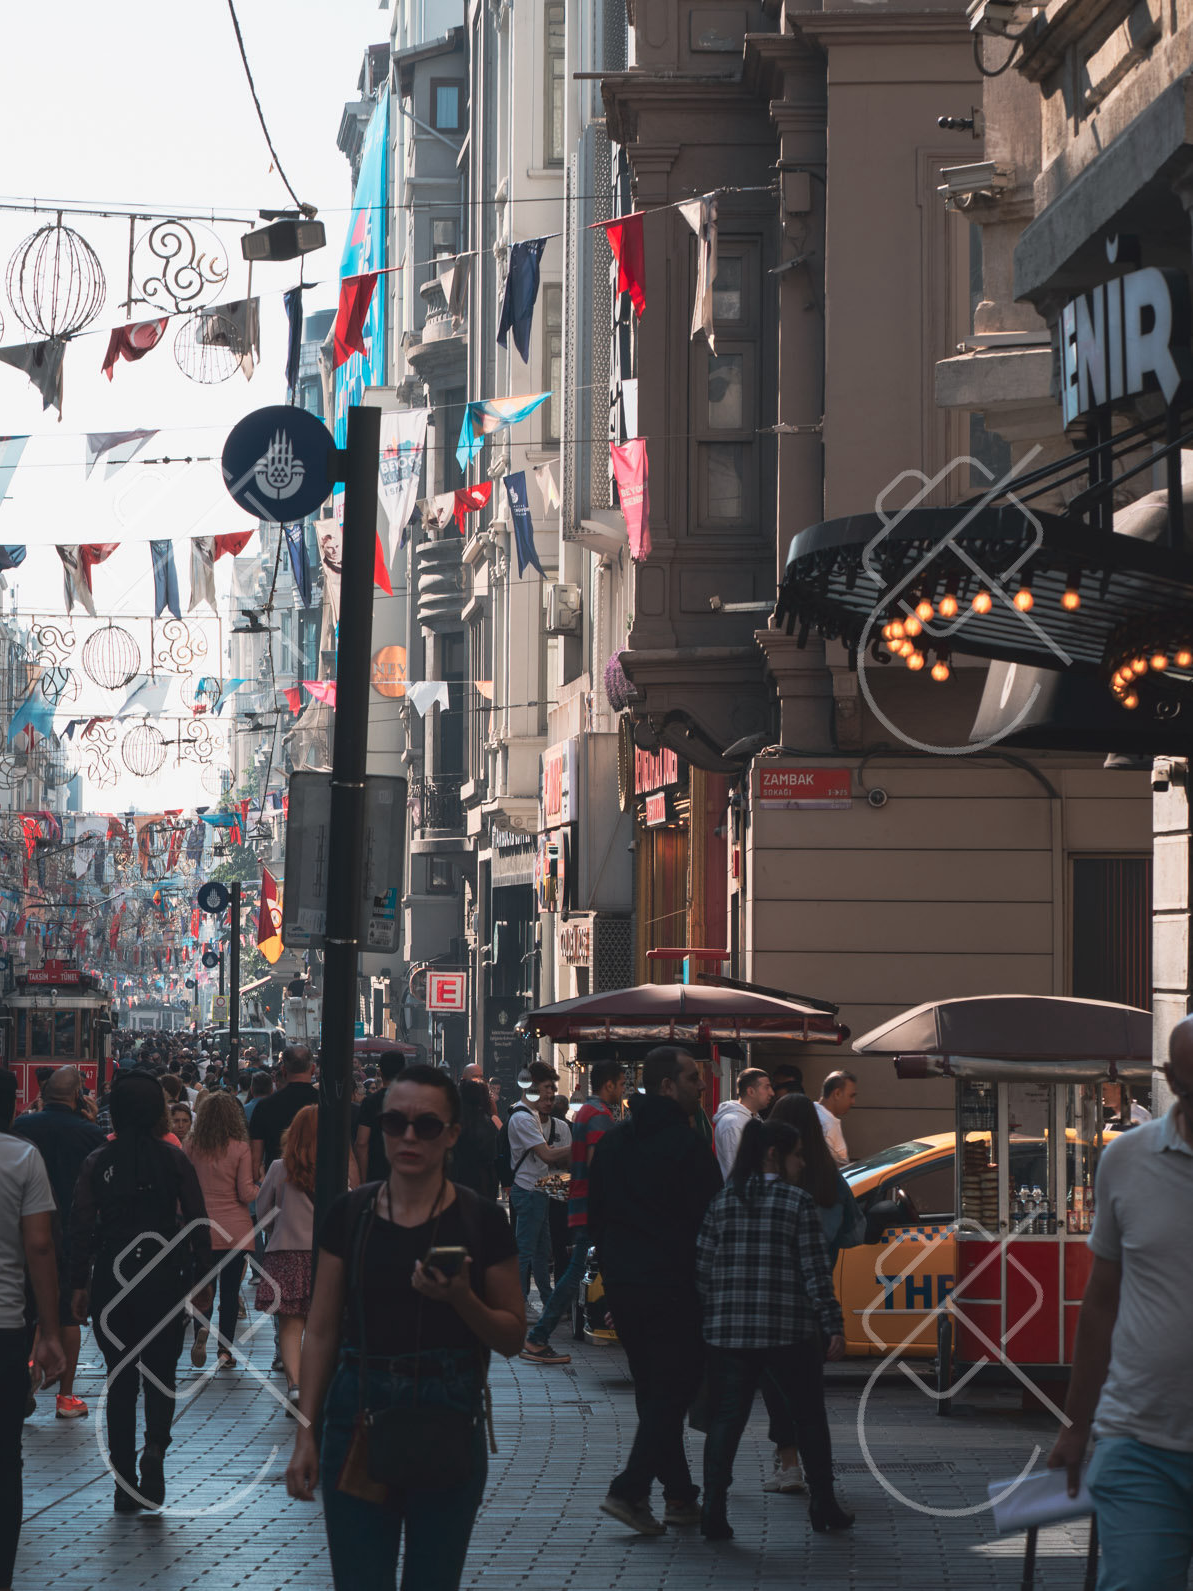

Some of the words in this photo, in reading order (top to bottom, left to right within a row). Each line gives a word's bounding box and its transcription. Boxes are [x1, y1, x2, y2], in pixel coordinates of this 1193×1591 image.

[763, 773, 814, 785] ZAMBAK
[763, 788, 792, 796] SOKAĞI
[29, 972, 49, 981] TAKSİM
[60, 972, 79, 981] TÜNEL
[436, 979, 457, 1004] E
